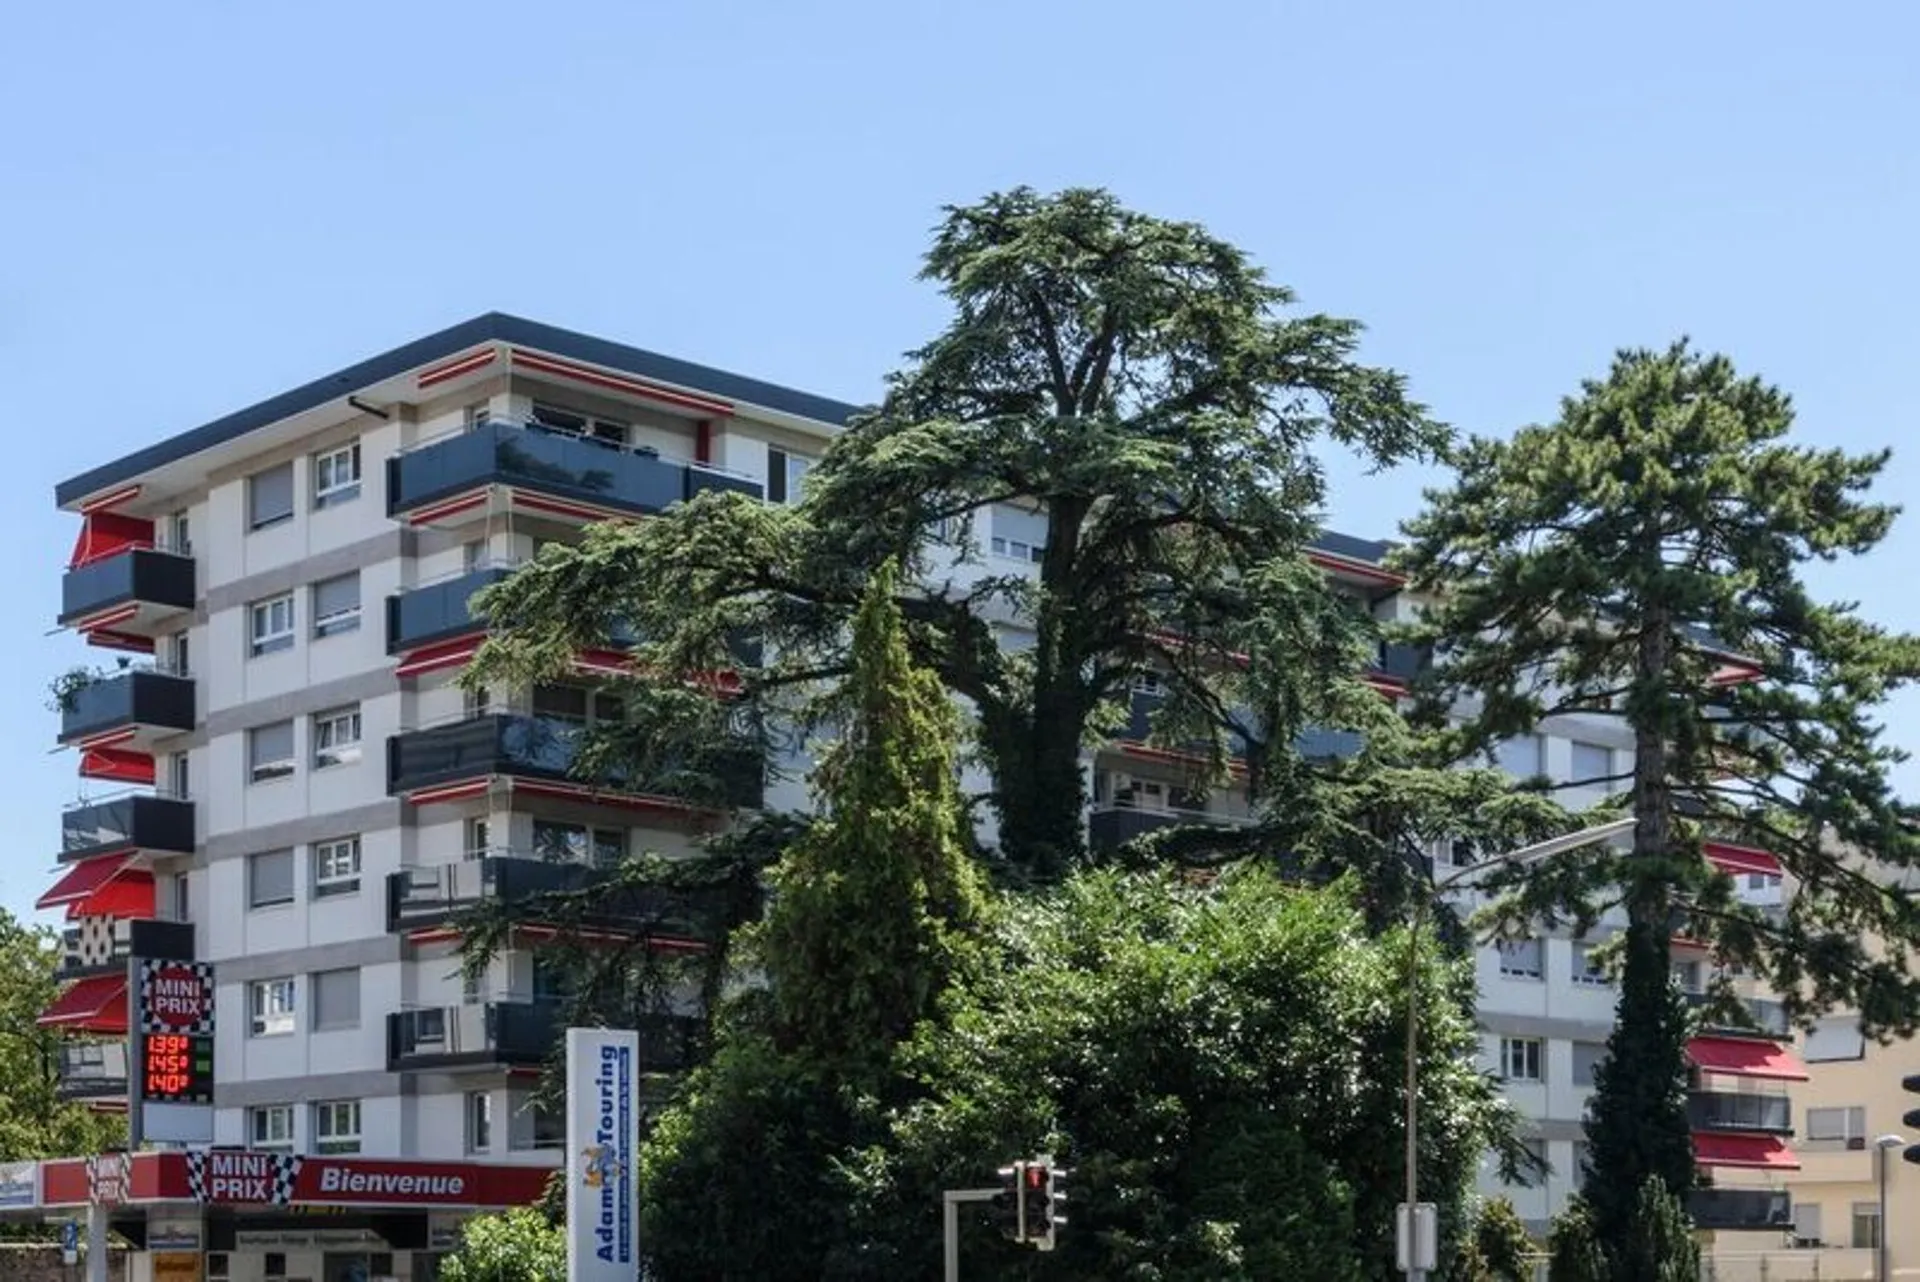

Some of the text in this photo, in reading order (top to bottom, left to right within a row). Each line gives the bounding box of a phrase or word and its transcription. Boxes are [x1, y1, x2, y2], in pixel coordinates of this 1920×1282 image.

[155, 979, 200, 996] MINI
[155, 998, 200, 1014] PRIX
[595, 1045, 618, 1144] Touring
[212, 1155, 268, 1177] MINI
[212, 1178, 268, 1200] PRIX
[320, 1167, 465, 1195] Bienvenue
